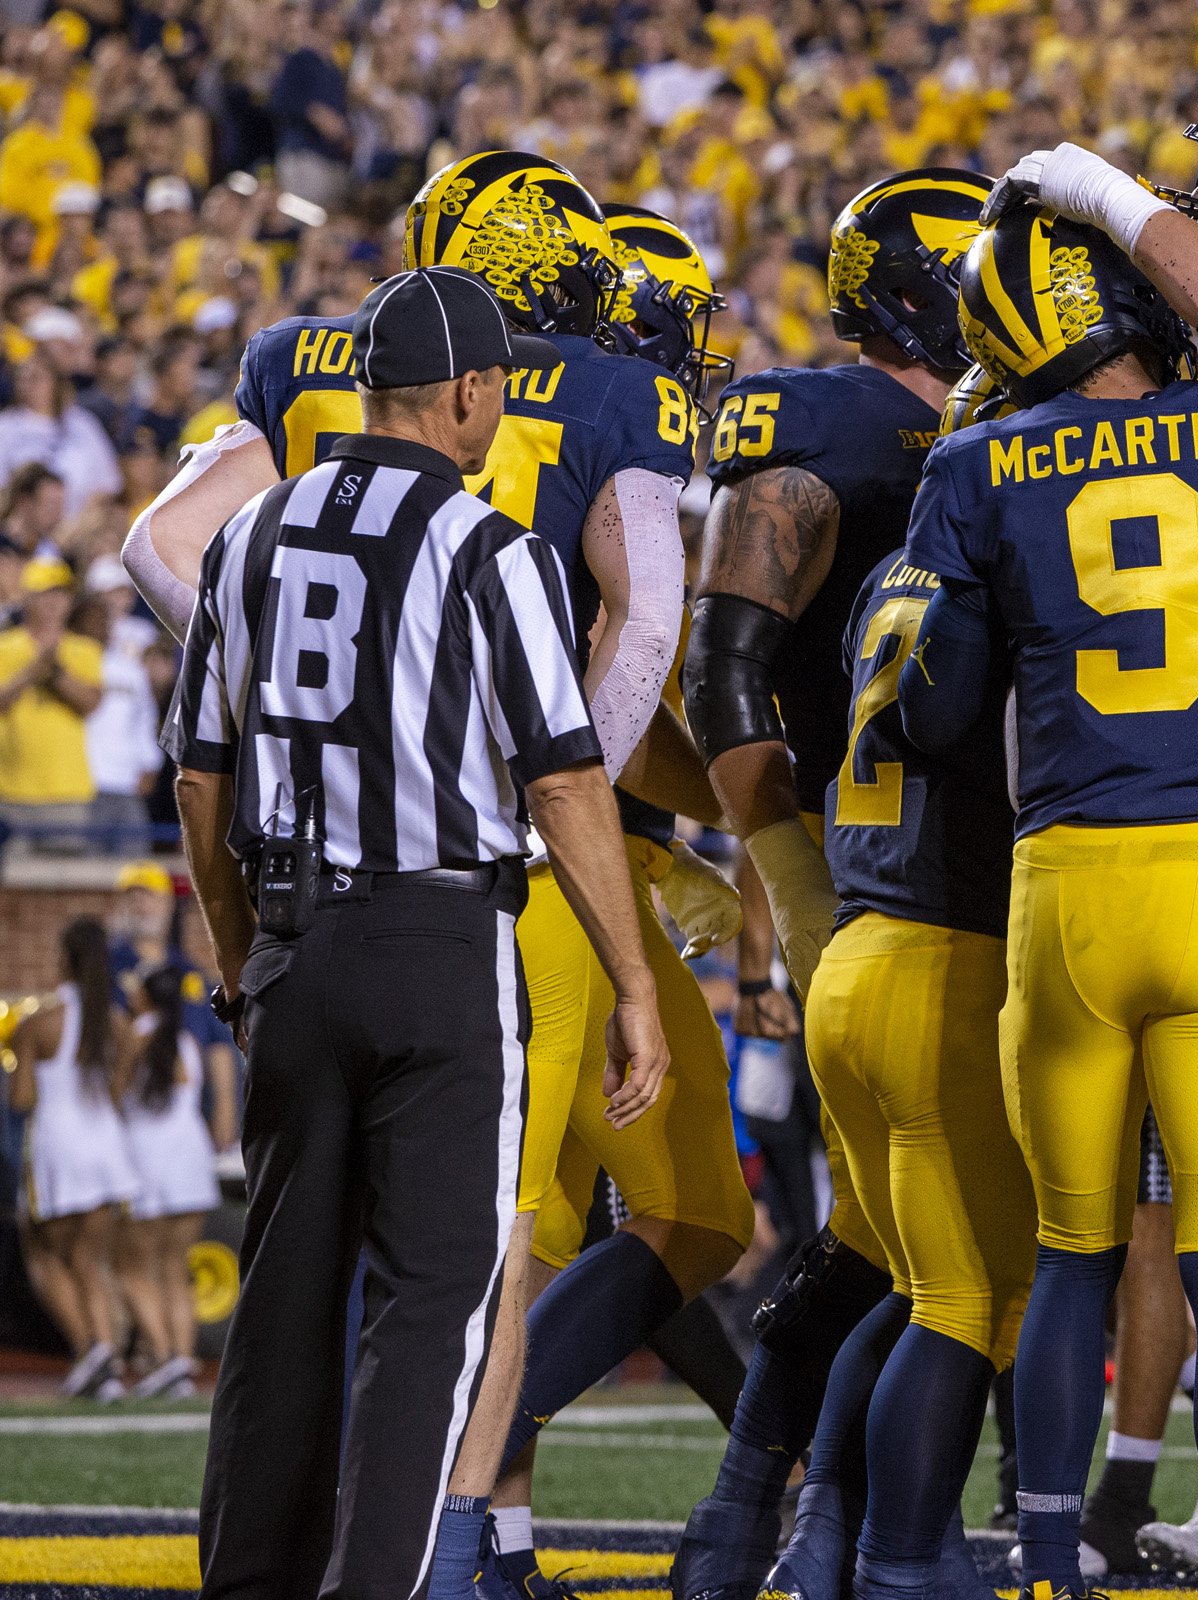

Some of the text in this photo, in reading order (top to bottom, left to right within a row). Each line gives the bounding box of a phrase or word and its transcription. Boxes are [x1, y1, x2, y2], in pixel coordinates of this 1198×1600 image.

[469, 245, 490, 255] (330)
[500, 287, 518, 296] TED
[714, 393, 781, 462] 65
[259, 545, 368, 723] B
[834, 597, 930, 826] 2
